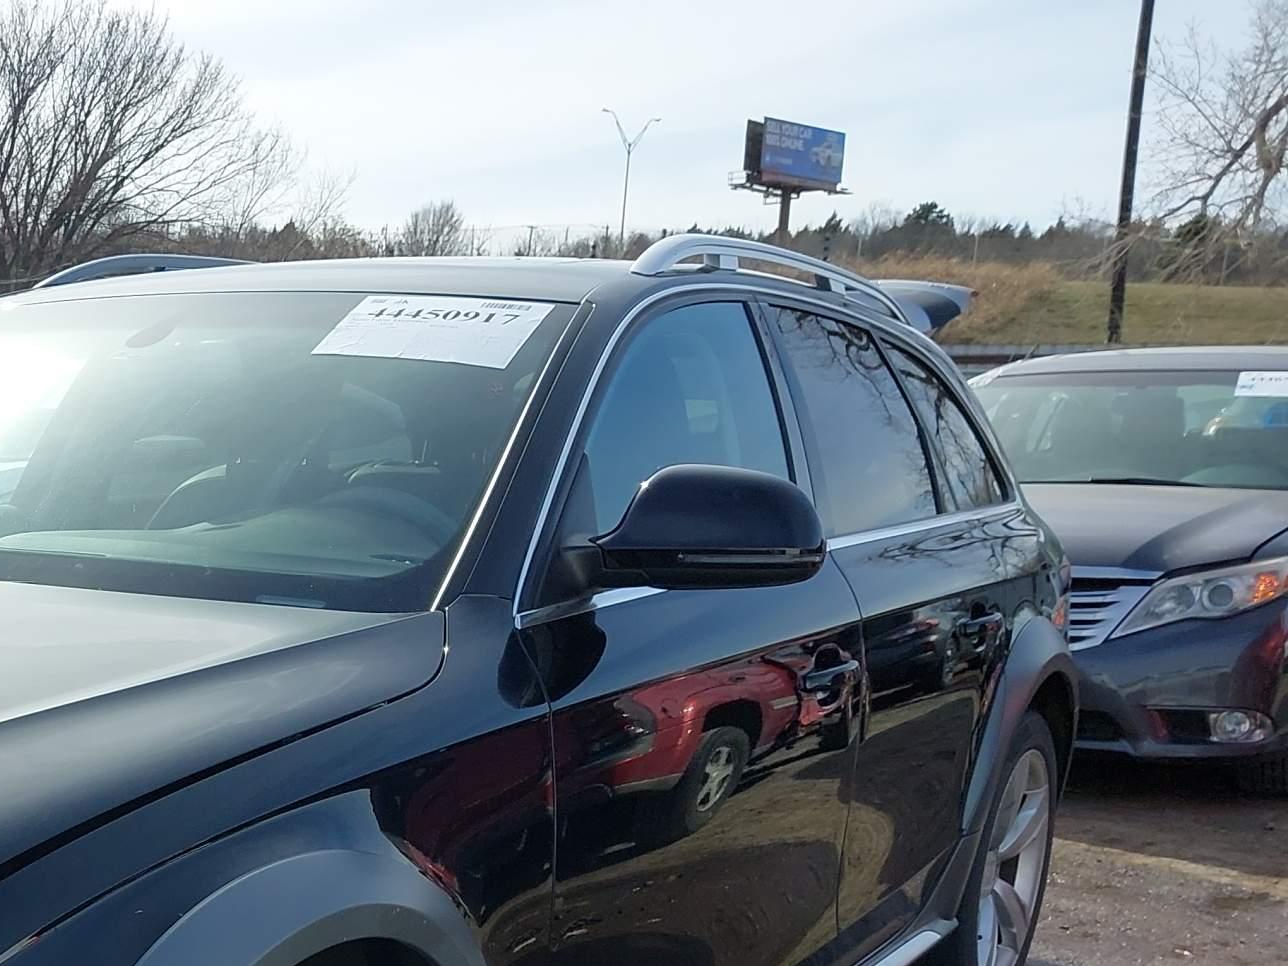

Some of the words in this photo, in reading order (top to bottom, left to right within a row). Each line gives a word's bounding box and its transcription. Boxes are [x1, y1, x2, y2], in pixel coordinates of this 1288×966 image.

[782, 124, 799, 137] YOUR
[799, 127, 813, 139] CAR
[781, 137, 805, 151] ONLINE
[368, 306, 521, 325] 44450917
